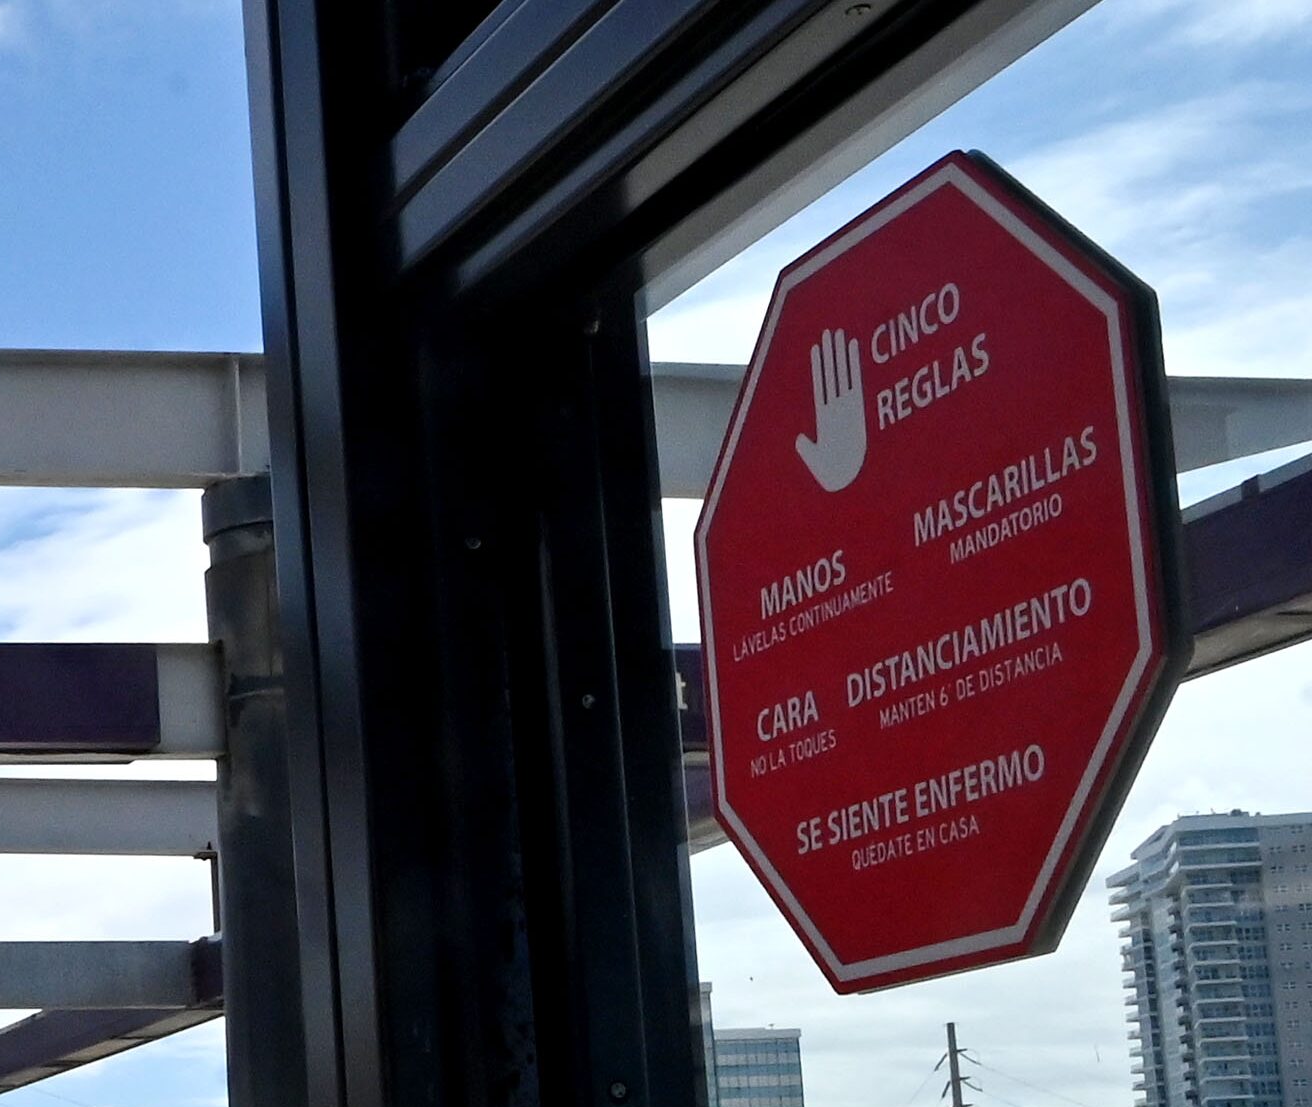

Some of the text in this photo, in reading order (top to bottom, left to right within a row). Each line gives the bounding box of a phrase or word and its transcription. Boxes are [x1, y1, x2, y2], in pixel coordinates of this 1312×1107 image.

[871, 283, 960, 364] CINCO
[877, 332, 990, 430] REGLAS
[914, 426, 1098, 546] MASCARILLAS
[949, 493, 1063, 564] MANDATORIO
[761, 550, 846, 620] MANOS
[789, 571, 894, 636] CONTINUAMENTE
[846, 578, 1092, 707] DISTANCIAMIENTO
[956, 673, 975, 701] DE
[979, 642, 1063, 692] DISTANCIA
[757, 691, 819, 742] CARA
[750, 729, 837, 778] NO LA TOQUES
[796, 744, 1045, 855] SE SIENTE ENFERMO
[917, 827, 935, 852] EN
[939, 814, 980, 845] CASA
